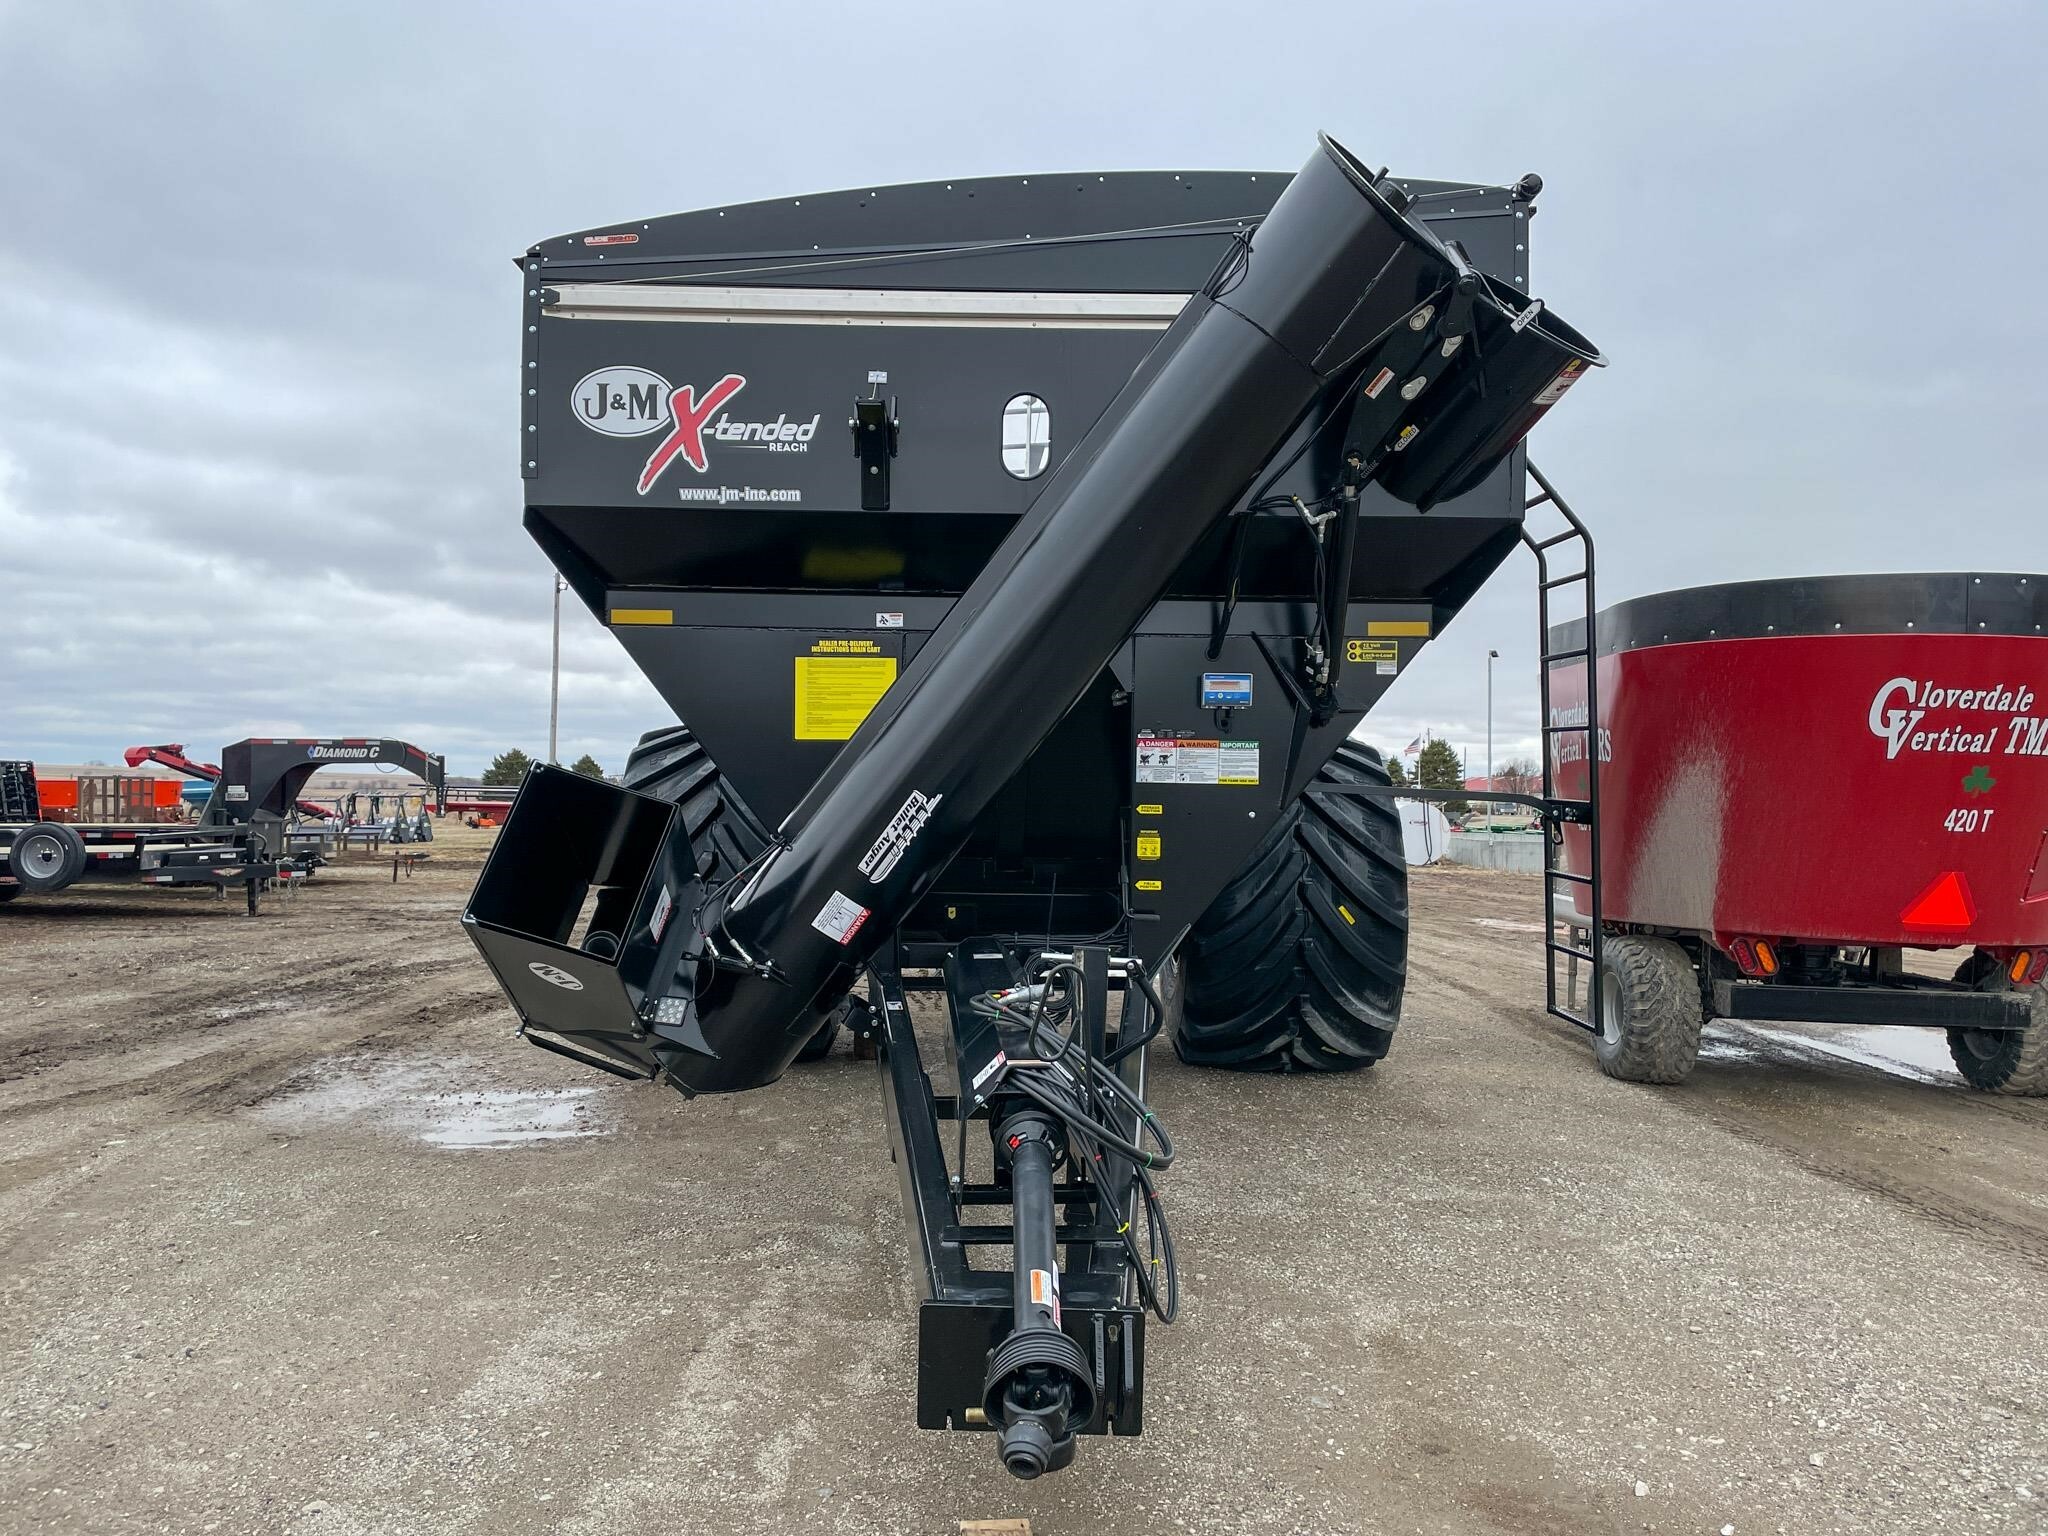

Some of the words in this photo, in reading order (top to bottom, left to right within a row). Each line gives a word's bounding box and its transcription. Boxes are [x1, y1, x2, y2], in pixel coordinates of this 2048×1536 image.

[1516, 308, 1535, 328] OPEN
[582, 383, 660, 421] J&M
[769, 442, 808, 452] REACH
[1396, 427, 1418, 449] CLOSED
[679, 486, 801, 504] www.jm-inc.com
[1869, 677, 2035, 737] Cloverdale
[1887, 709, 1998, 760] Vertical
[2004, 716, 2048, 756] TM
[313, 745, 368, 758] DIAMOND
[369, 746, 380, 758] C
[890, 795, 921, 833] Bullet
[1943, 808, 1979, 833] 420
[1981, 809, 1994, 833] T
[864, 831, 892, 870] Auger
[841, 914, 865, 944] DANGER
[531, 965, 582, 989] J&M
